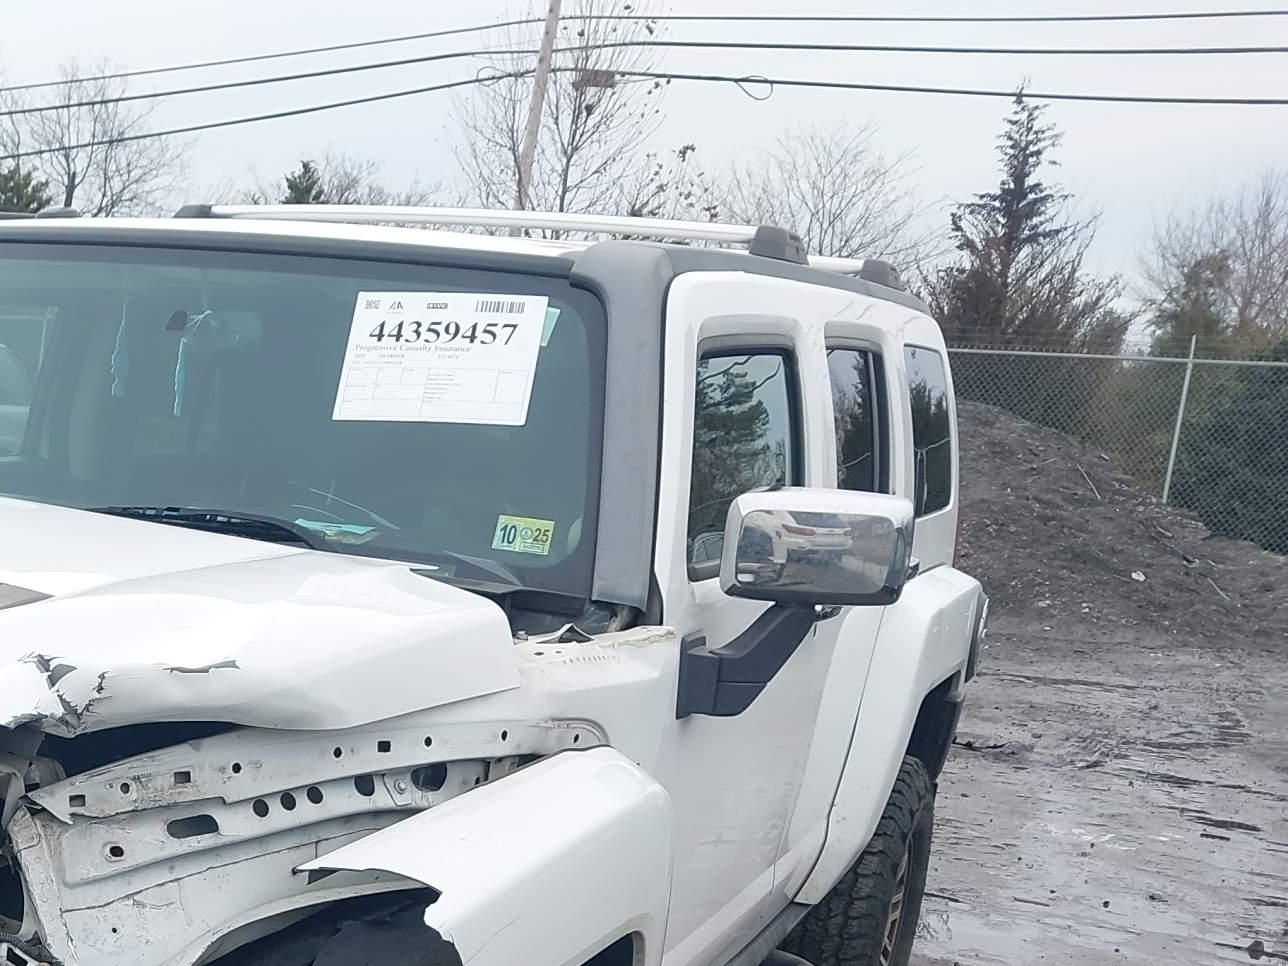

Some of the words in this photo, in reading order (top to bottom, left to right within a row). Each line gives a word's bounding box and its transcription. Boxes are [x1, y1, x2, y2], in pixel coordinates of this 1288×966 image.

[368, 319, 519, 346] 44359457
[354, 343, 397, 352] Progressive
[399, 344, 432, 353] Casualty
[434, 345, 472, 353] Insurance
[499, 524, 518, 545] 10
[532, 527, 550, 544] 25
